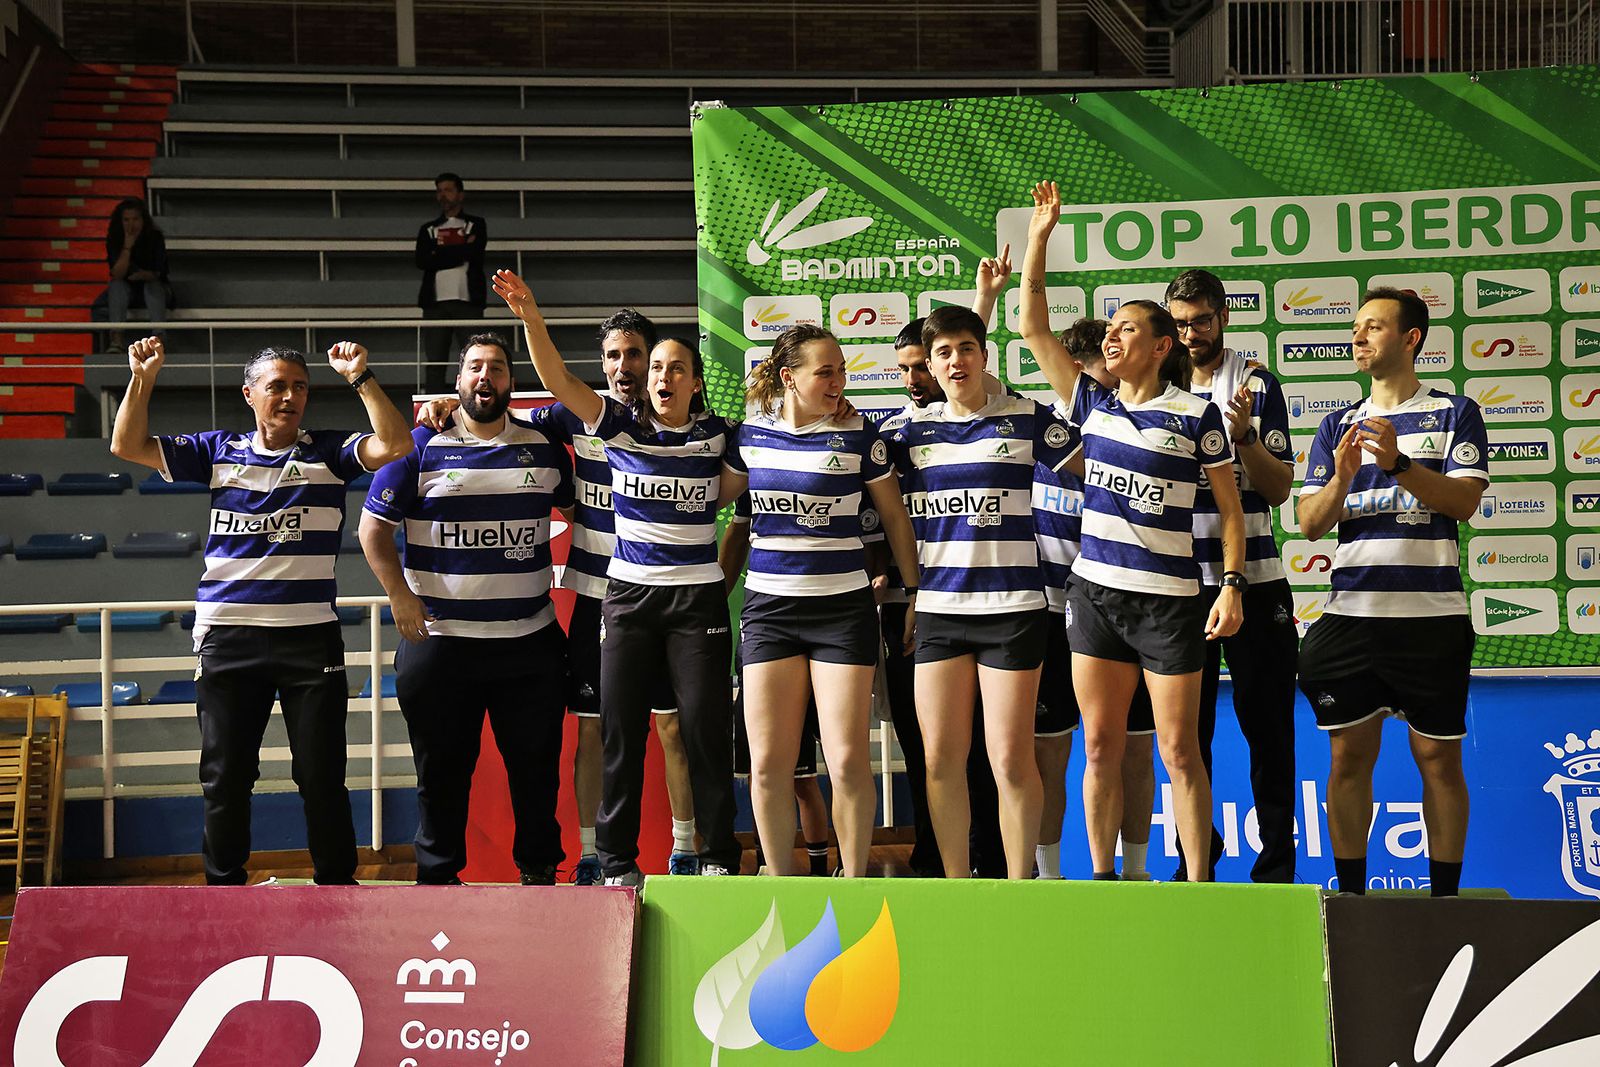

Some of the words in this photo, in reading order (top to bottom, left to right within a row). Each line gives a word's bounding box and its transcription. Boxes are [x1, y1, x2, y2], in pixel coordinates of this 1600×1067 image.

[1057, 209, 1203, 263] TOP
[1230, 203, 1311, 257] 10
[895, 235, 960, 250] ESPAÑA
[781, 254, 961, 281] BADMINTON
[1226, 297, 1255, 308] ONEX
[1048, 304, 1079, 314] rdrola
[1293, 307, 1351, 316] BADMINTON
[761, 324, 792, 332] BADMI
[1237, 349, 1258, 358] RÍAS
[1311, 346, 1349, 358] YONEX
[1308, 399, 1352, 409] LOTERÍAS
[1485, 406, 1545, 415] BADMINTON
[865, 411, 892, 423] YON
[1503, 445, 1544, 458] YONEX
[624, 475, 707, 500] Huelva
[1089, 462, 1165, 504] Huelva
[677, 501, 705, 512] original
[753, 491, 832, 515] Huelva
[1130, 500, 1163, 515] original
[1499, 499, 1545, 509] LOTERÍAS
[214, 510, 300, 533] Huelva
[798, 516, 829, 527] original
[968, 515, 1000, 526] original
[1398, 512, 1429, 524] original
[269, 531, 301, 542] original
[439, 521, 535, 547] Huelva
[506, 548, 534, 559] origina
[1499, 554, 1549, 564] Iberdrola
[1581, 787, 1592, 795] ET
[1566, 801, 1577, 829] MARIS
[1570, 832, 1582, 868] PORTUS
[400, 1020, 530, 1058] Consejo
